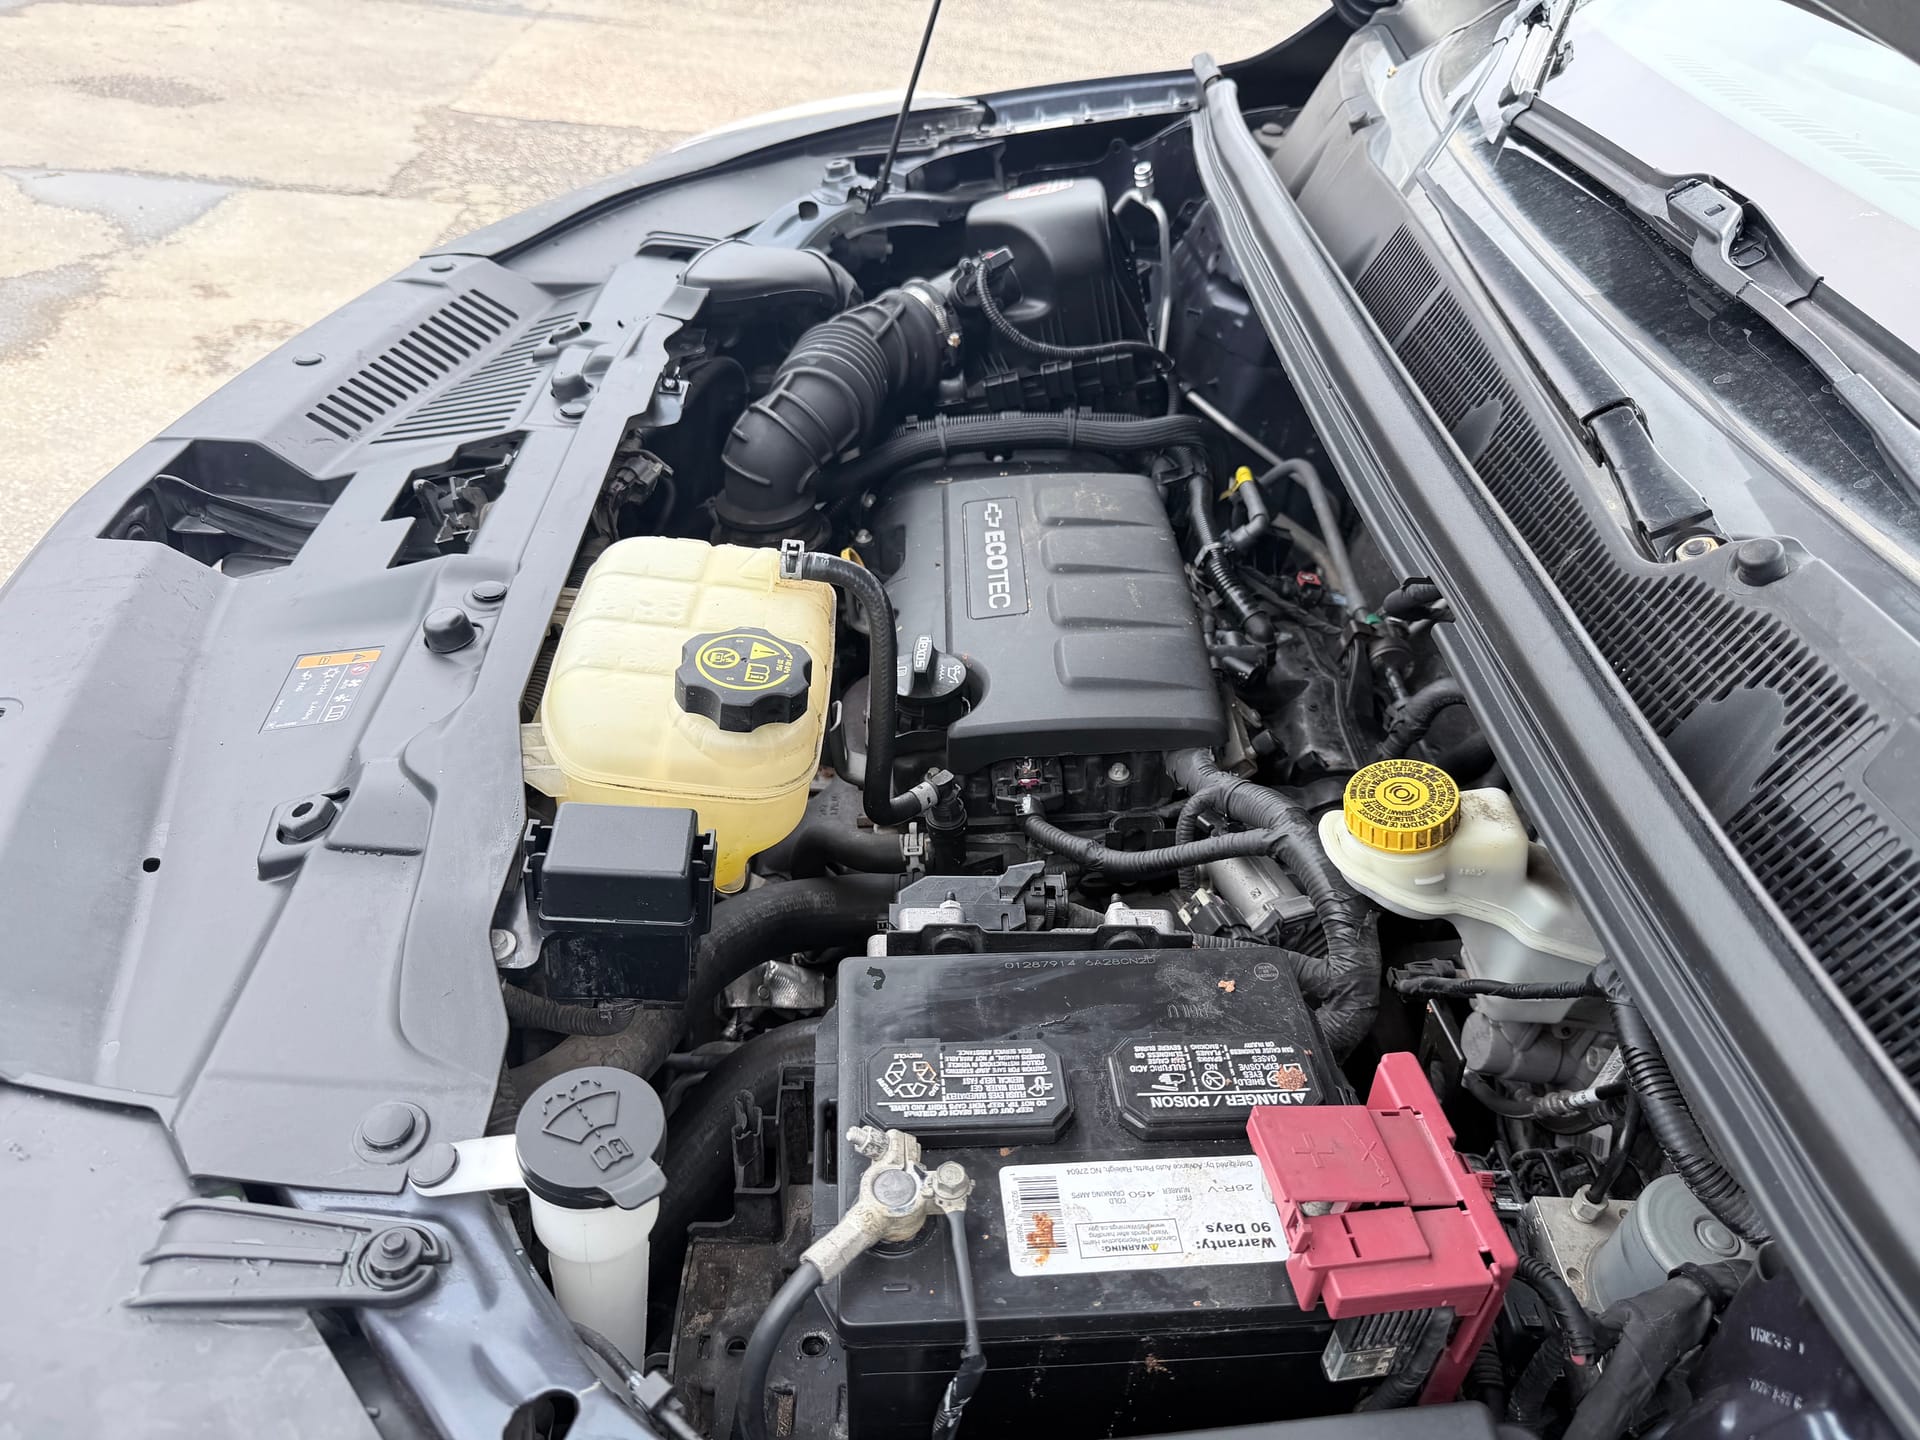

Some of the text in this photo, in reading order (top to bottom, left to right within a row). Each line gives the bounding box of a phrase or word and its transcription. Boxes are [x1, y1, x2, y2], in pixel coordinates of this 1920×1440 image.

[985, 530, 1010, 609] ECOTEC
[916, 637, 932, 668] dexos
[1004, 960, 1076, 969] 01287914
[1251, 1054, 1277, 1062] GASES
[1149, 1064, 1187, 1072] SULFURIC
[1006, 1091, 1027, 1099] FLUSH
[1150, 1092, 1292, 1108] DANGER / POISON
[1215, 1160, 1253, 1168] Distributed
[1066, 1168, 1089, 1176] 27604
[1207, 1184, 1254, 1192] 26R-V
[1091, 1190, 1125, 1198] CRANKING
[1109, 1197, 1126, 1205] COLD
[1205, 1222, 1271, 1234] 90 Days
[1101, 1244, 1149, 1252] WARNING:
[1196, 1237, 1276, 1251] Warranty:
